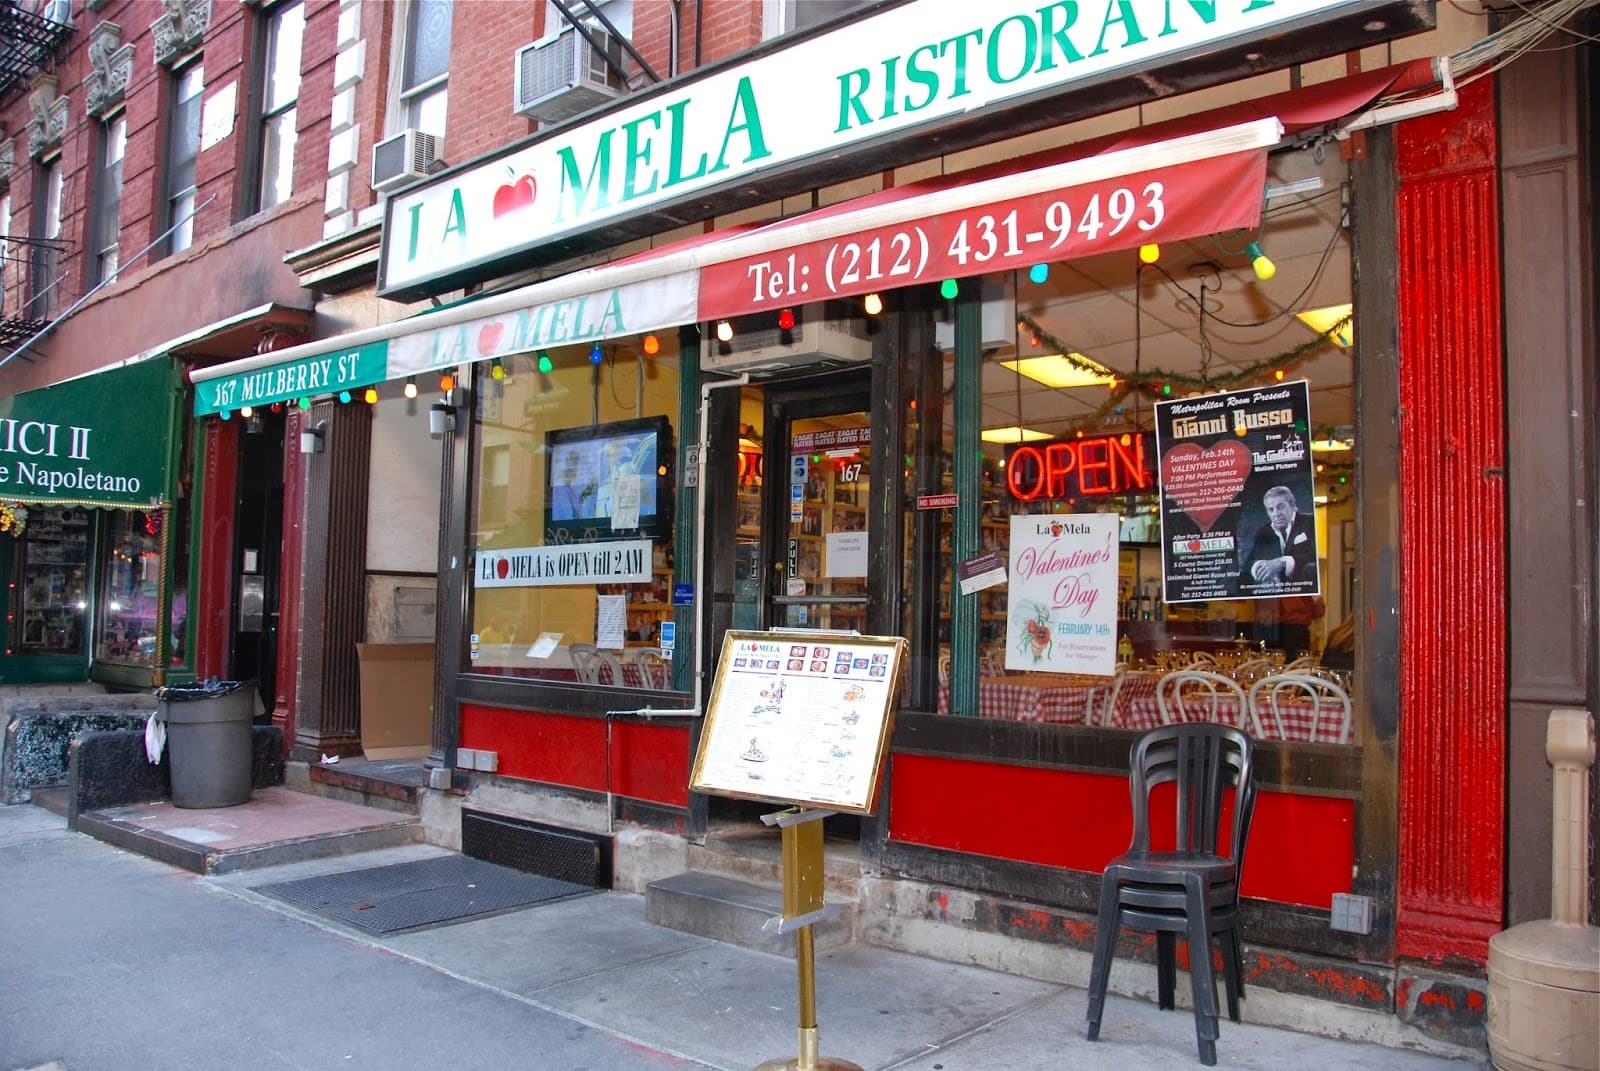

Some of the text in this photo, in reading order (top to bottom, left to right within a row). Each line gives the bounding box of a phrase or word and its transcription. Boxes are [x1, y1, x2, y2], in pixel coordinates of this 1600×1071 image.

[408, 76, 772, 263] LA MELA
[748, 181, 1166, 302] Tel: (212) 431-9493
[431, 288, 627, 365] LA MELA
[212, 353, 359, 407] 167 MULBERRY ST
[1171, 390, 1290, 415] Metropolitan Room Presents
[1172, 408, 1293, 439] Gianni Russo
[0, 418, 60, 456] ICI
[794, 440, 814, 448] RATED
[837, 436, 858, 444] RATED
[815, 431, 835, 439] ZAGAT
[1170, 454, 1199, 464] Sunday,
[1252, 452, 1266, 464] The
[841, 464, 861, 482] 167
[1008, 433, 1145, 502] OPEN
[1171, 460, 1235, 473] VALENTINES DAY
[1254, 462, 1298, 472] Motion Picture
[16, 462, 140, 493] Napoletano
[1197, 470, 1237, 480] Performance
[1200, 484, 1244, 496] 212-206-0440
[929, 498, 956, 506] SMOKING
[1036, 524, 1090, 535] La Mela
[1175, 538, 1232, 552] LA MELA
[1016, 532, 1112, 581] Valentine's
[482, 557, 496, 580] LA
[510, 555, 541, 579] MELA
[545, 556, 555, 577] is
[558, 552, 590, 577] OPEN
[593, 550, 610, 575] till
[1051, 572, 1099, 618] Day
[1058, 623, 1110, 636] FEBRUARY 14th
[760, 644, 780, 652] MELA
